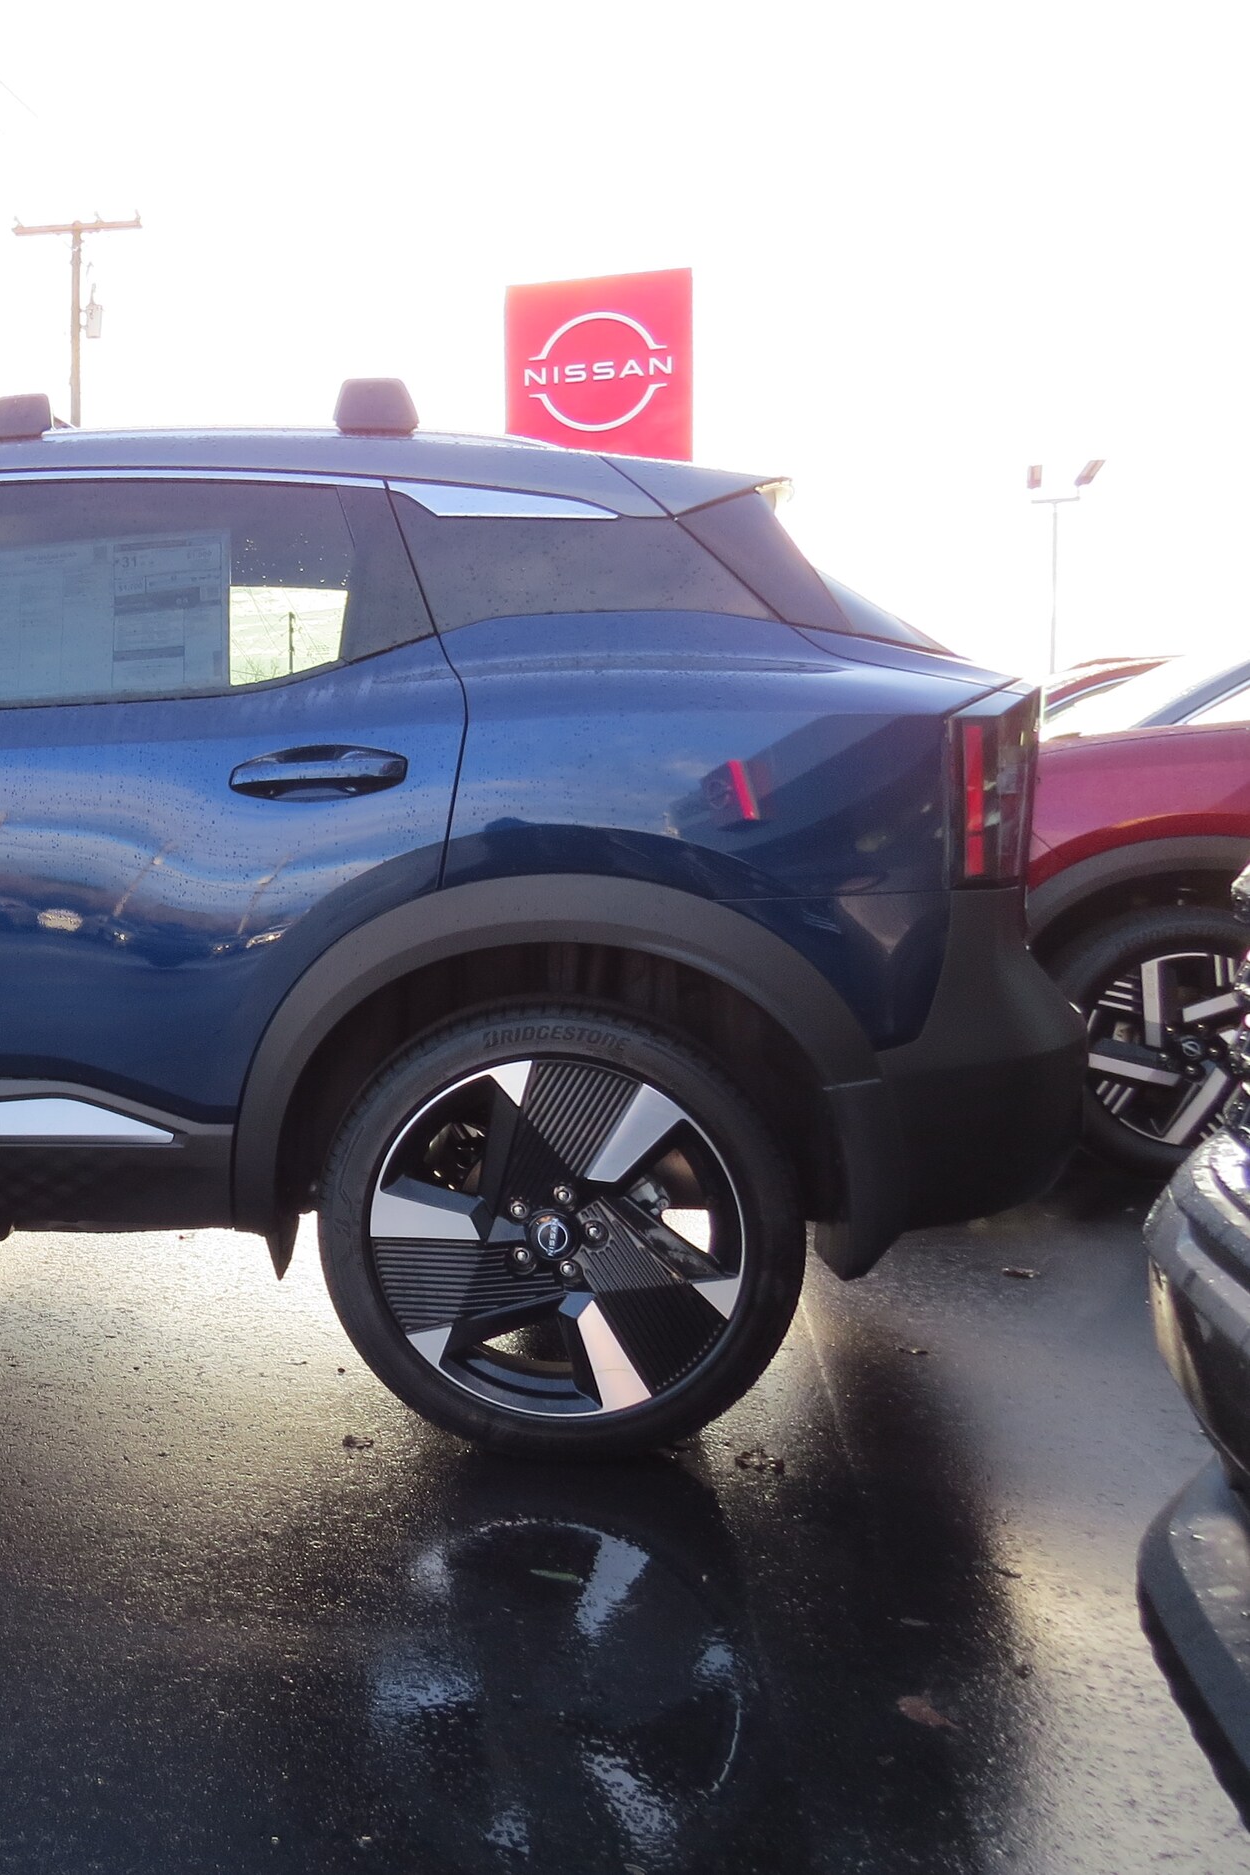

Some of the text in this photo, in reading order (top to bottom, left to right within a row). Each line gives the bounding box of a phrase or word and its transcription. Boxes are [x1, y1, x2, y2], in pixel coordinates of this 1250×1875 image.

[524, 356, 672, 387] NISSAN
[483, 1025, 631, 1051] BRIDGESTONE
[547, 1219, 560, 1257] NISSAN
